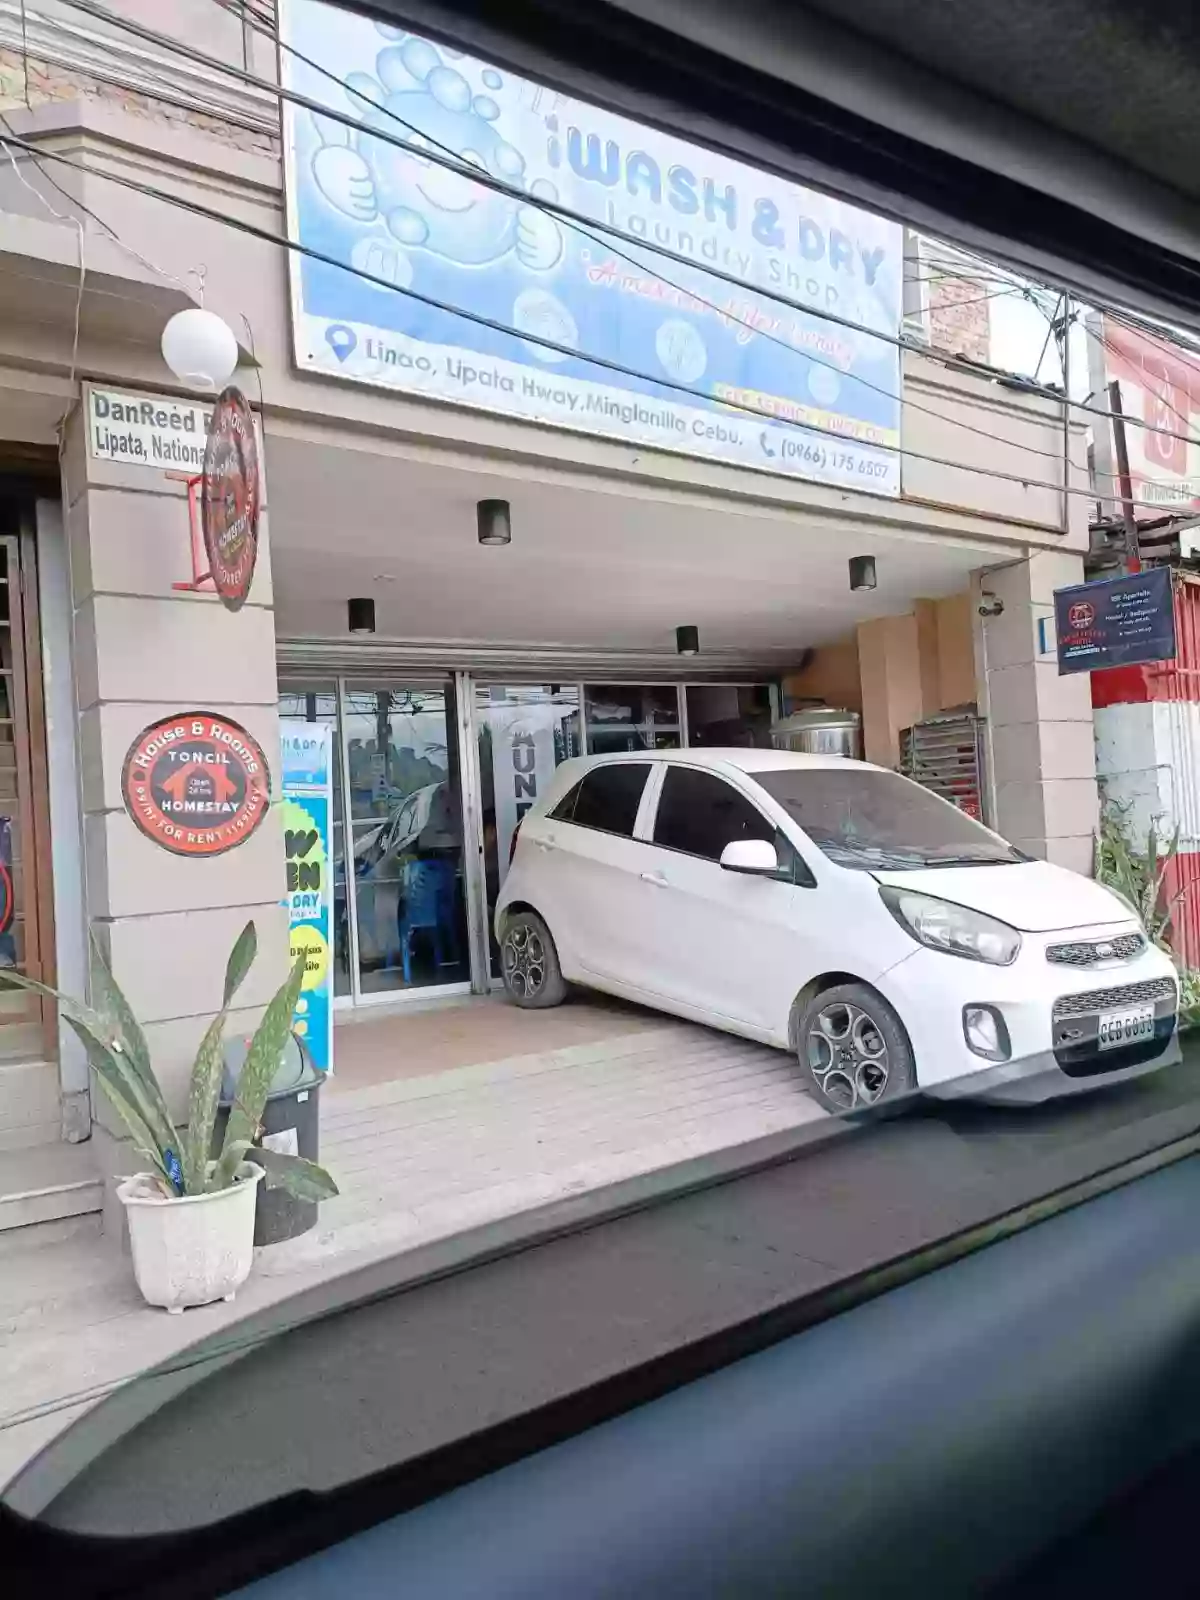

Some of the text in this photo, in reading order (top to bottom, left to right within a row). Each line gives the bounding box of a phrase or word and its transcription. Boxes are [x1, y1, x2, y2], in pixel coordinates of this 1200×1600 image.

[544, 112, 738, 232] iWASH
[751, 197, 786, 251] &
[797, 214, 886, 287] DRY
[606, 200, 751, 276] Laundry
[768, 256, 838, 307] Shop
[94, 393, 196, 434] DanReed
[366, 338, 438, 377] Linao,
[447, 357, 515, 392] Lipata
[691, 417, 743, 446] Cebu.
[781, 437, 826, 469] (0966)
[832, 449, 854, 473] 175
[95, 425, 148, 463] Lipata,
[152, 432, 206, 466] Nationa
[135, 721, 259, 774] House & Rooms
[168, 750, 231, 765] TONCIL
[161, 799, 241, 814] HOMESTAY
[156, 817, 184, 841] FOR
[187, 829, 224, 845] RENT
